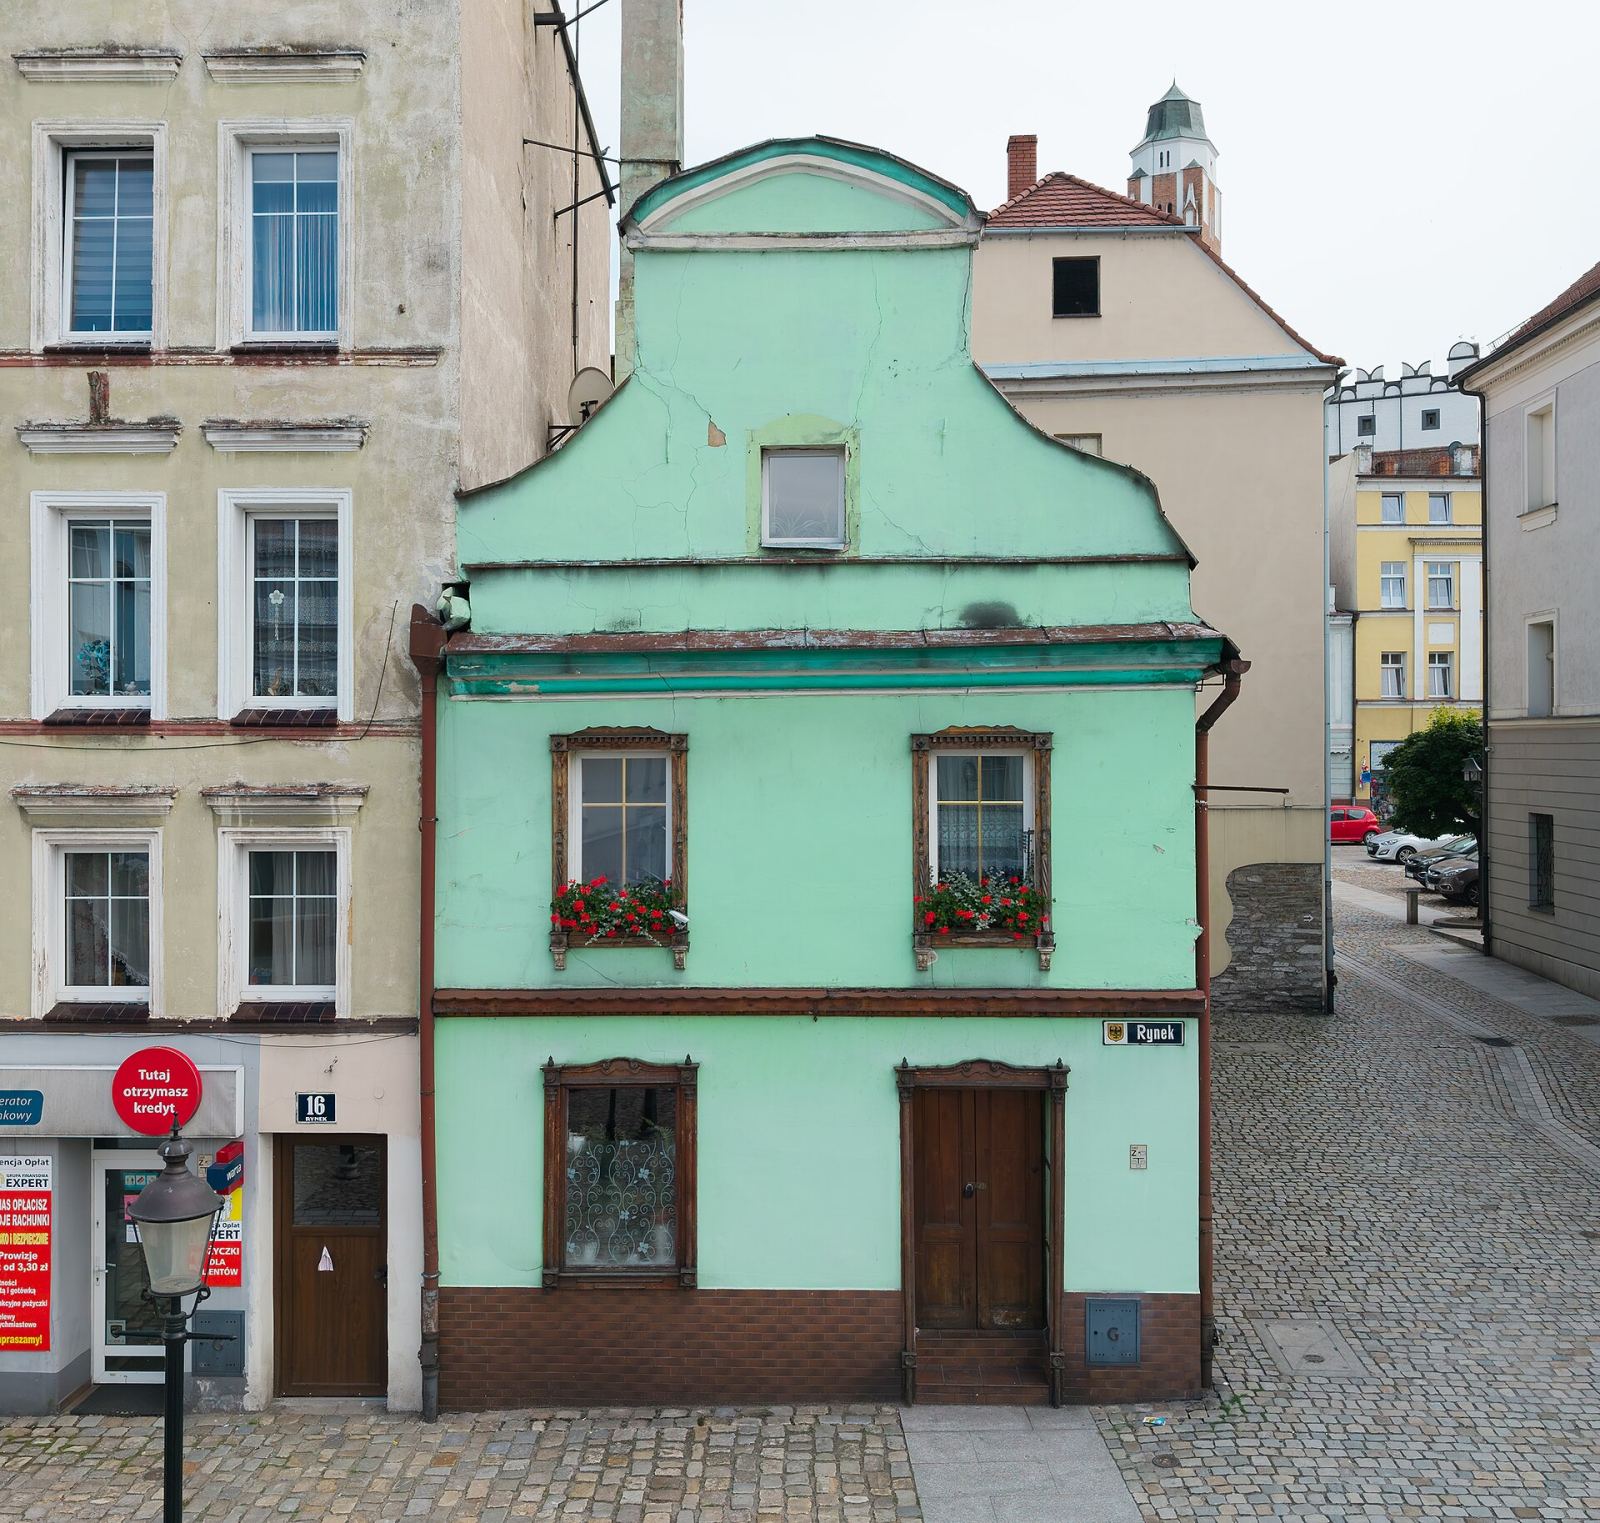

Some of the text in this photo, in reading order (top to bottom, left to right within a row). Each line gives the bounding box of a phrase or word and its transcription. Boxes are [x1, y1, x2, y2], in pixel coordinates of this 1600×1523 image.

[1137, 1024, 1175, 1043] Rynek
[138, 1069, 170, 1083] Tutaj
[123, 1087, 188, 1099] otrzymasz
[133, 1101, 176, 1116] kredyt
[306, 1095, 325, 1116] 16
[24, 1158, 49, 1167] Opłat
[6, 1178, 49, 1188] EXPERT
[0, 1198, 47, 1211] AS OPŁACISZ
[12, 1213, 50, 1226] RACHUNKI
[0, 1251, 38, 1262] Prowizje
[3, 1262, 15, 1271] od
[17, 1262, 38, 1272] 3,30
[39, 1262, 49, 1271] zł
